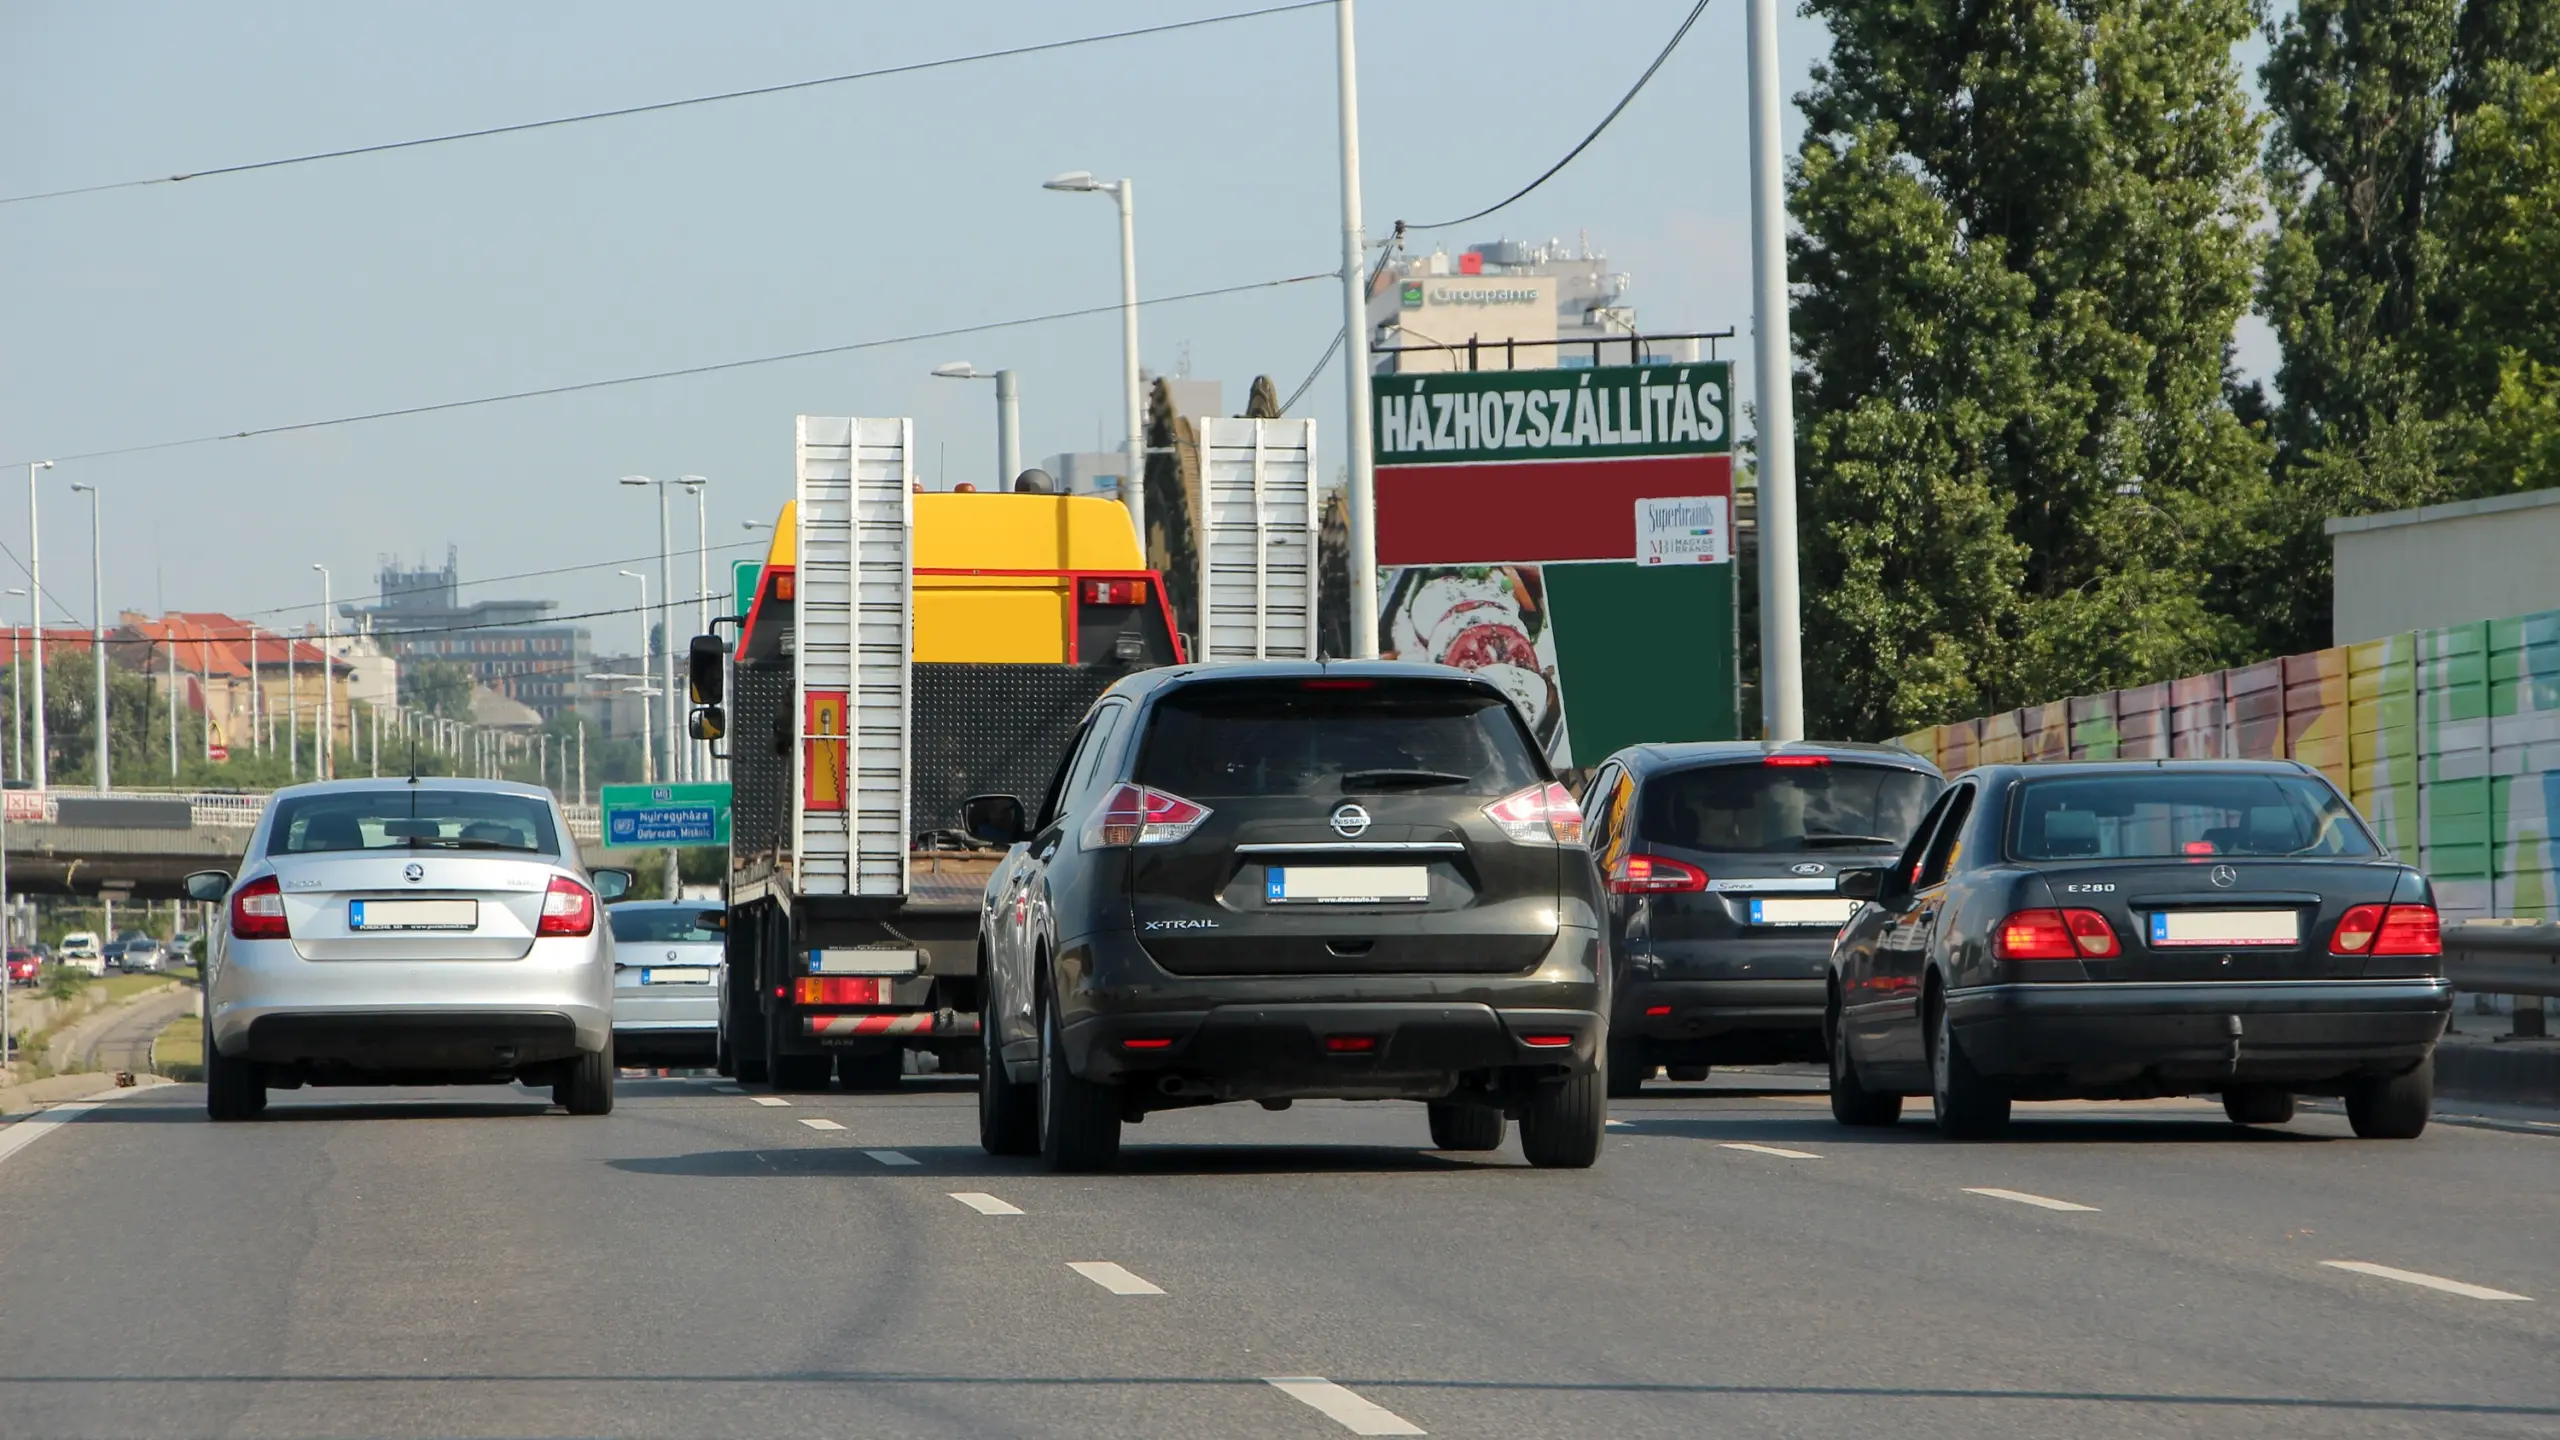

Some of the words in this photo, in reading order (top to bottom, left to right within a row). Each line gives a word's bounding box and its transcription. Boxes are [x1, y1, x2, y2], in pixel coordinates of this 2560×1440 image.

[1431, 286, 1539, 304] Groupama
[1382, 369, 1724, 452] HÁZHOZSZÁLLÍTÁS
[1648, 502, 1714, 533] Superbrands
[1333, 817, 1368, 826] NISSAN
[1272, 884, 1281, 895] H
[2068, 884, 2079, 893] E
[2081, 883, 2116, 893] 280
[1145, 919, 1220, 931] X-TRAIL
